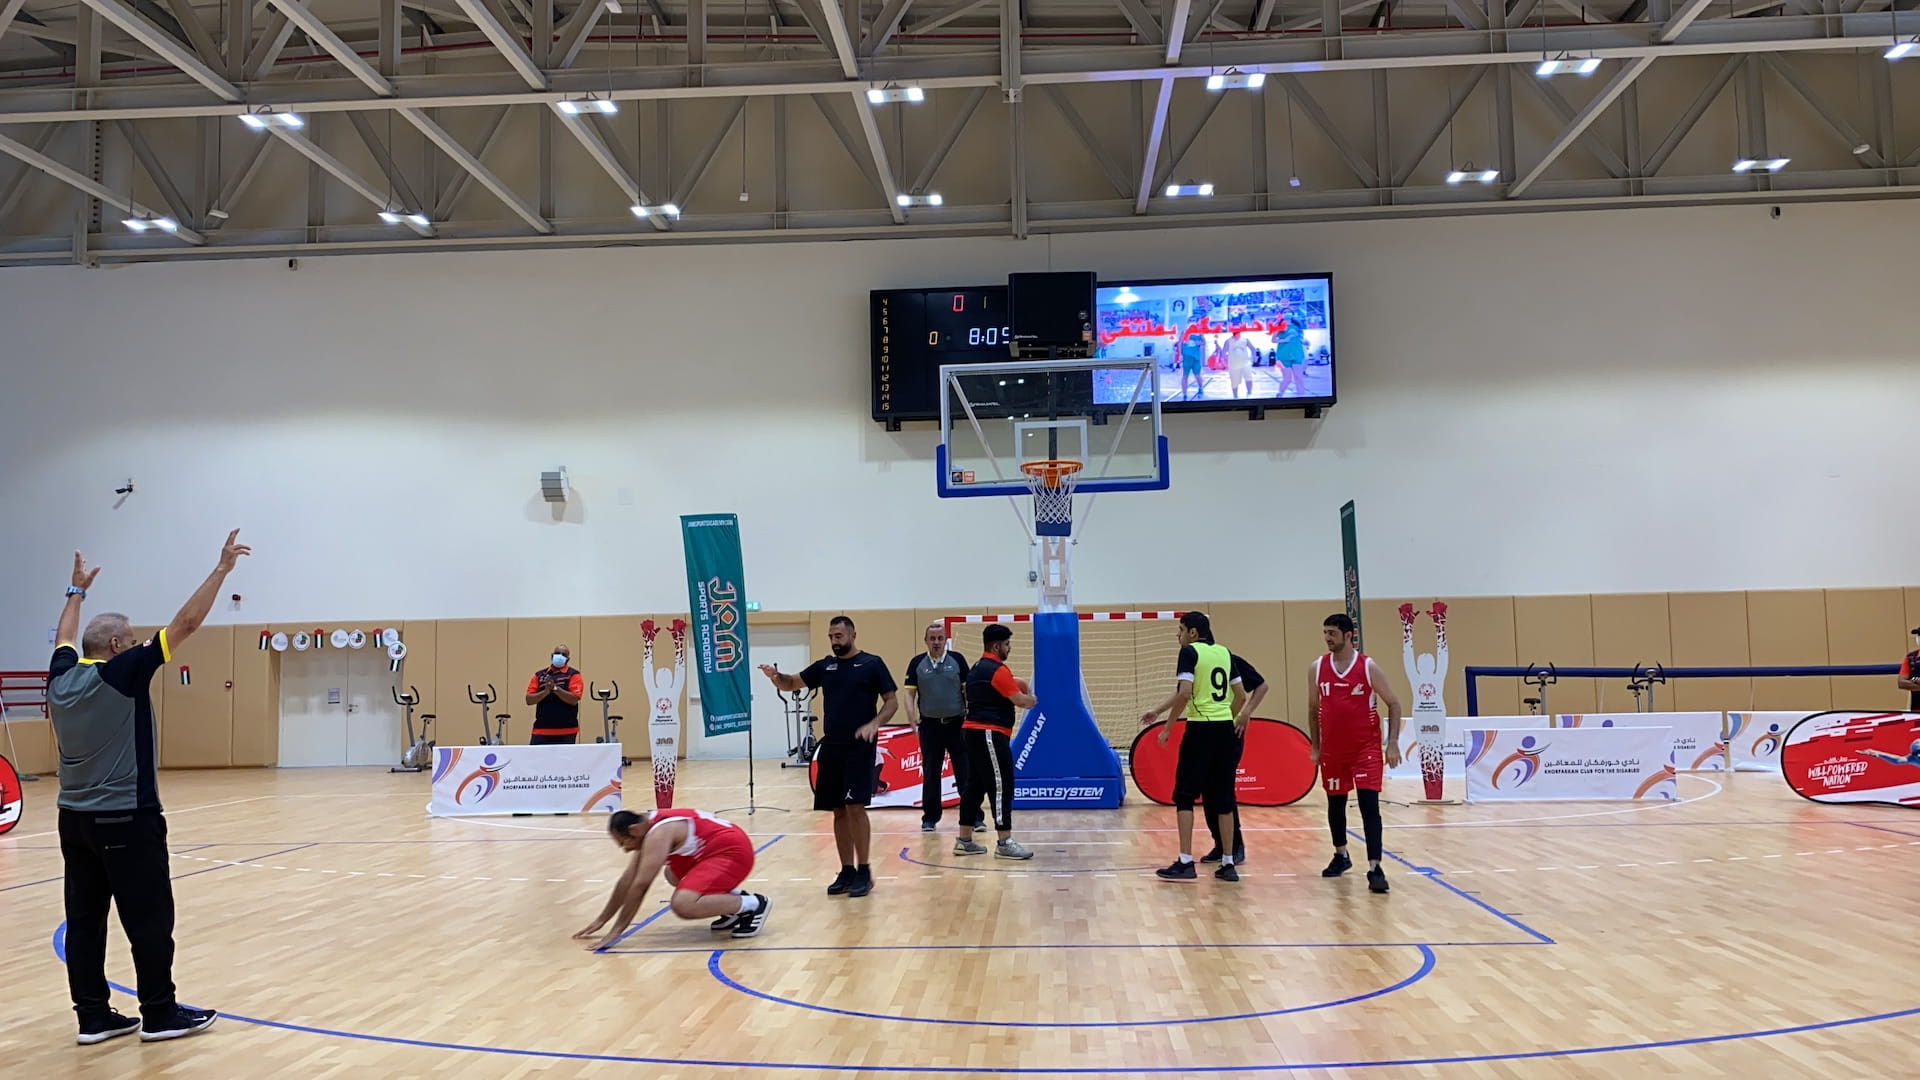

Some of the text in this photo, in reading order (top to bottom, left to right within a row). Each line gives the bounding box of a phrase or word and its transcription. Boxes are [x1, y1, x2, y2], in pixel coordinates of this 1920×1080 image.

[882, 298, 888, 306] 4
[952, 294, 964, 312] 0
[882, 308, 888, 316] 5
[882, 317, 888, 325] 6
[882, 326, 889, 334] 7
[1182, 316, 1224, 342] بكم
[882, 336, 889, 344] 8
[928, 331, 938, 345] 0
[882, 346, 889, 354] 9
[881, 355, 889, 363] 10
[881, 364, 889, 372] 11
[881, 374, 889, 382] 12
[881, 383, 889, 392] 13
[881, 393, 890, 401] 14
[881, 402, 890, 411] 15
[698, 581, 713, 673] SPORTS ACADEMY
[1211, 667, 1228, 702] 9
[1320, 682, 1330, 696] 11
[1015, 711, 1047, 771] HYDROPLAY
[1621, 758, 1640, 767] نادي
[1808, 761, 1868, 778] WILLPOWERED
[1328, 778, 1340, 790] 11
[1823, 774, 1851, 787] NATION
[1014, 787, 1104, 800] SPORTSYSTEM
